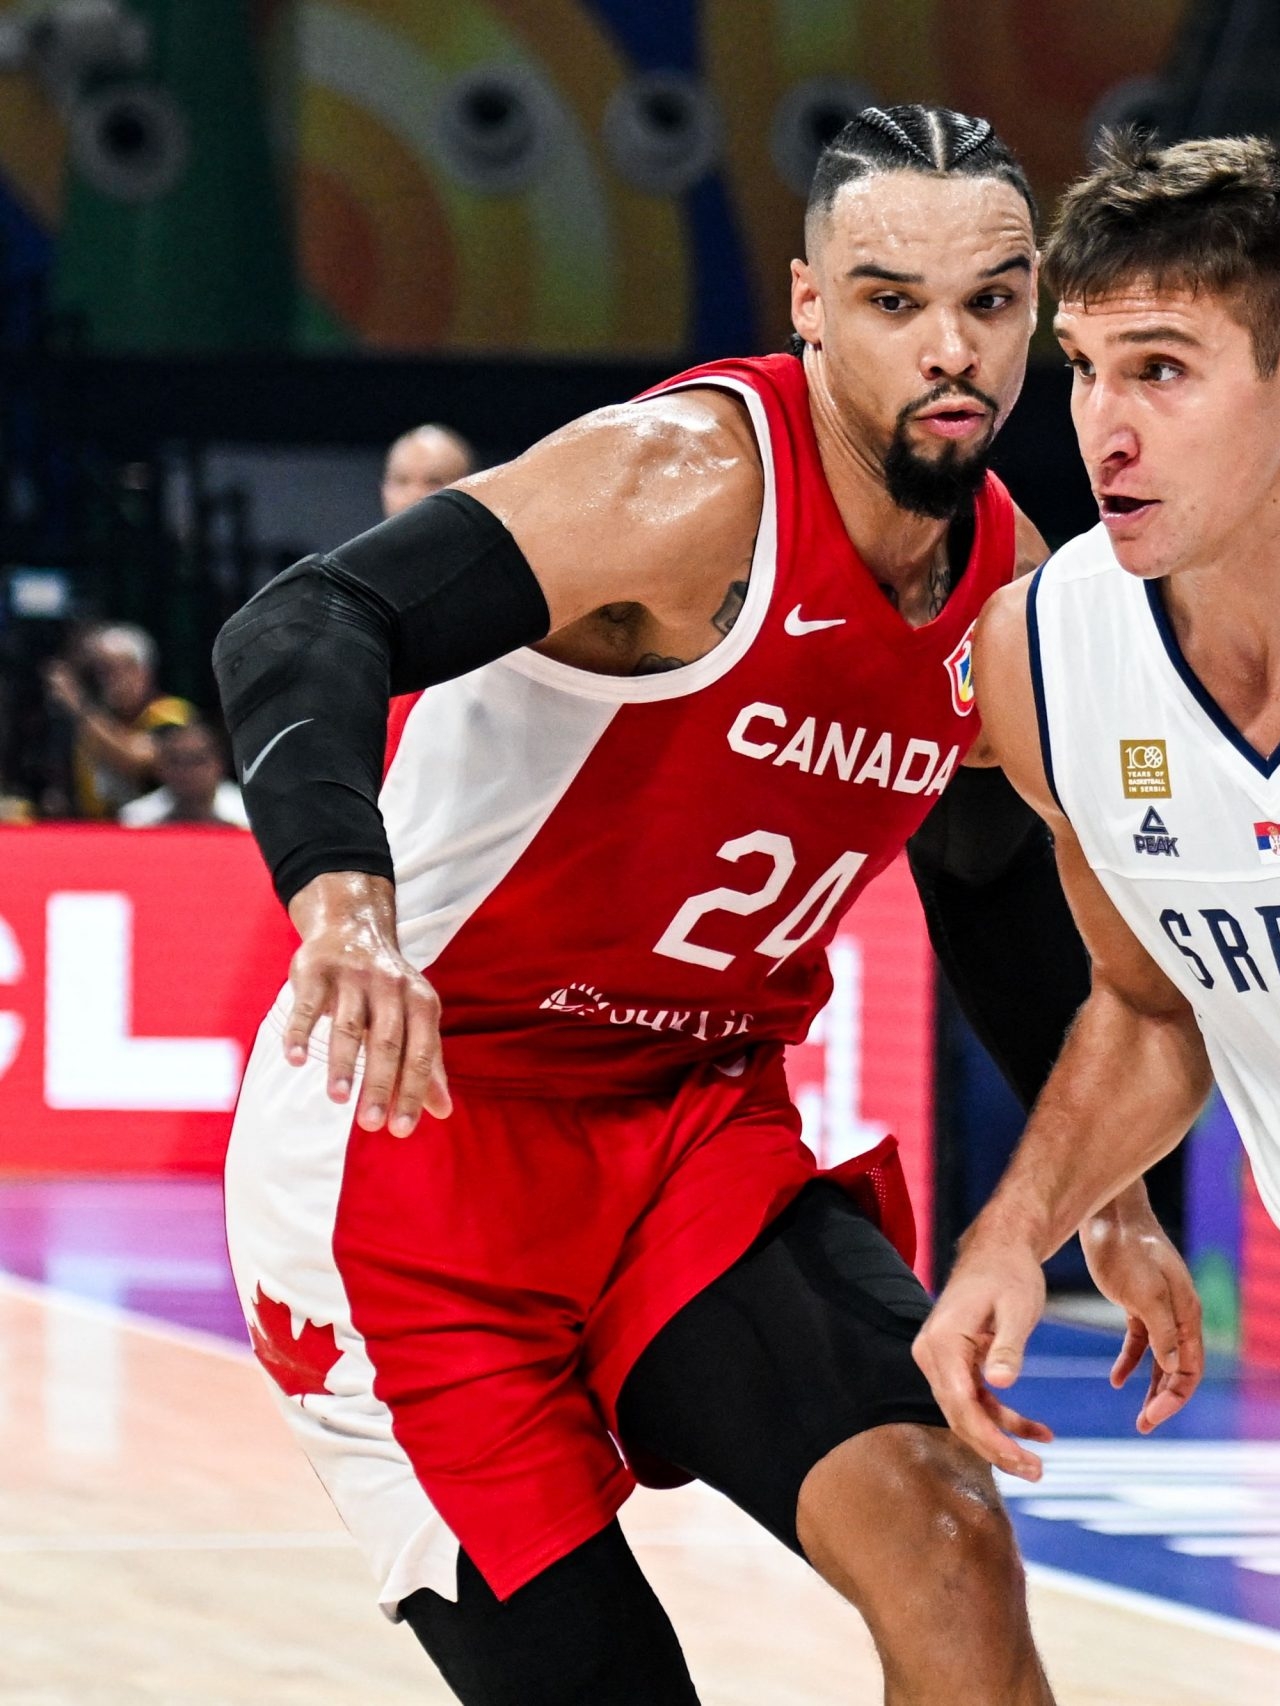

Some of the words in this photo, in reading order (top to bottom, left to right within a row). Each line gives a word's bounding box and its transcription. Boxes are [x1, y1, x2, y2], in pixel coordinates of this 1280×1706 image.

[727, 702, 959, 797] CANADA
[652, 829, 869, 978] 24
[1133, 833, 1180, 858] PEAK
[0, 890, 242, 1111] L
